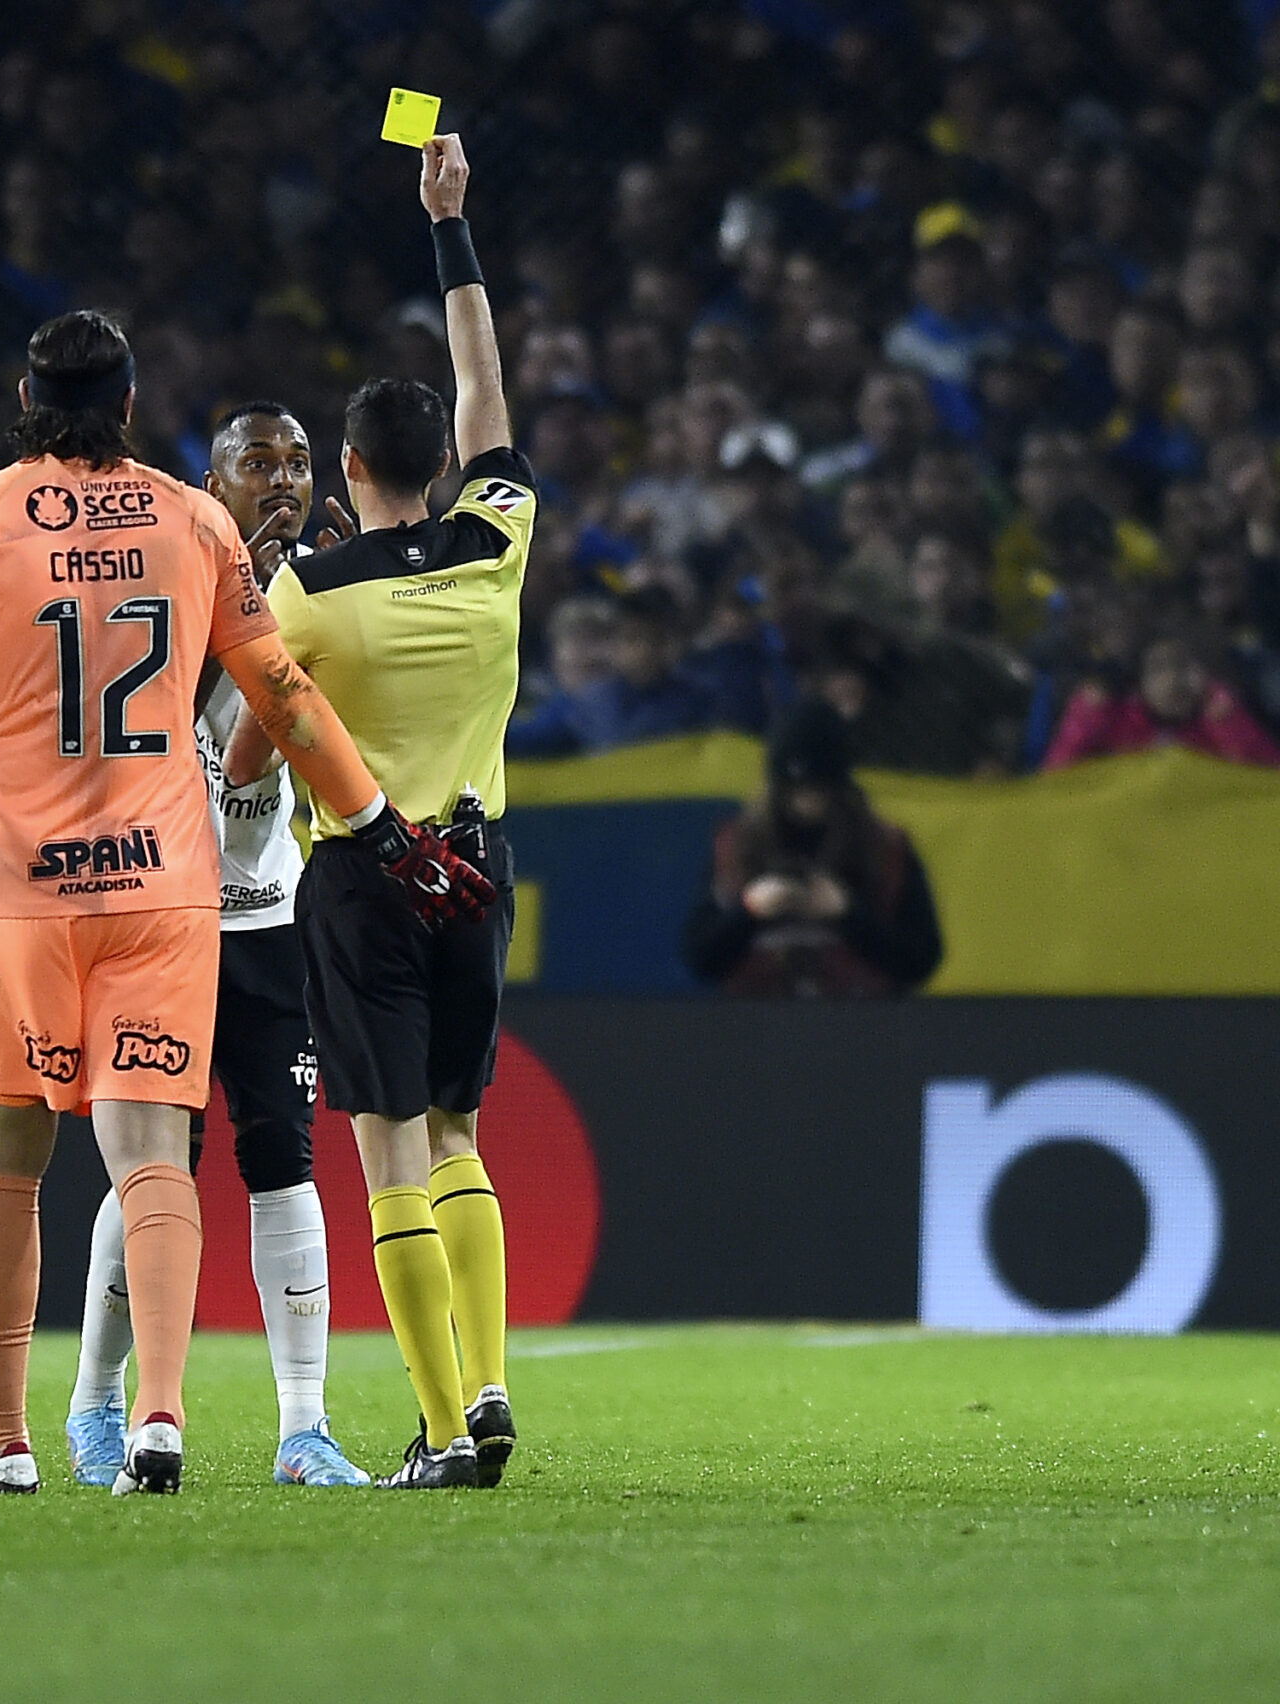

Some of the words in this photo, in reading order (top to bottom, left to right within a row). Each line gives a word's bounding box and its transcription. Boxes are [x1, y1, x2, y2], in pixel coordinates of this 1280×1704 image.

[80, 480, 152, 493] UNIVERSO
[83, 492, 154, 517] SCCP
[391, 579, 458, 600] marathon
[33, 596, 172, 758] 12
[57, 877, 145, 897] ATACADISTA
[112, 1032, 190, 1077] Poty
